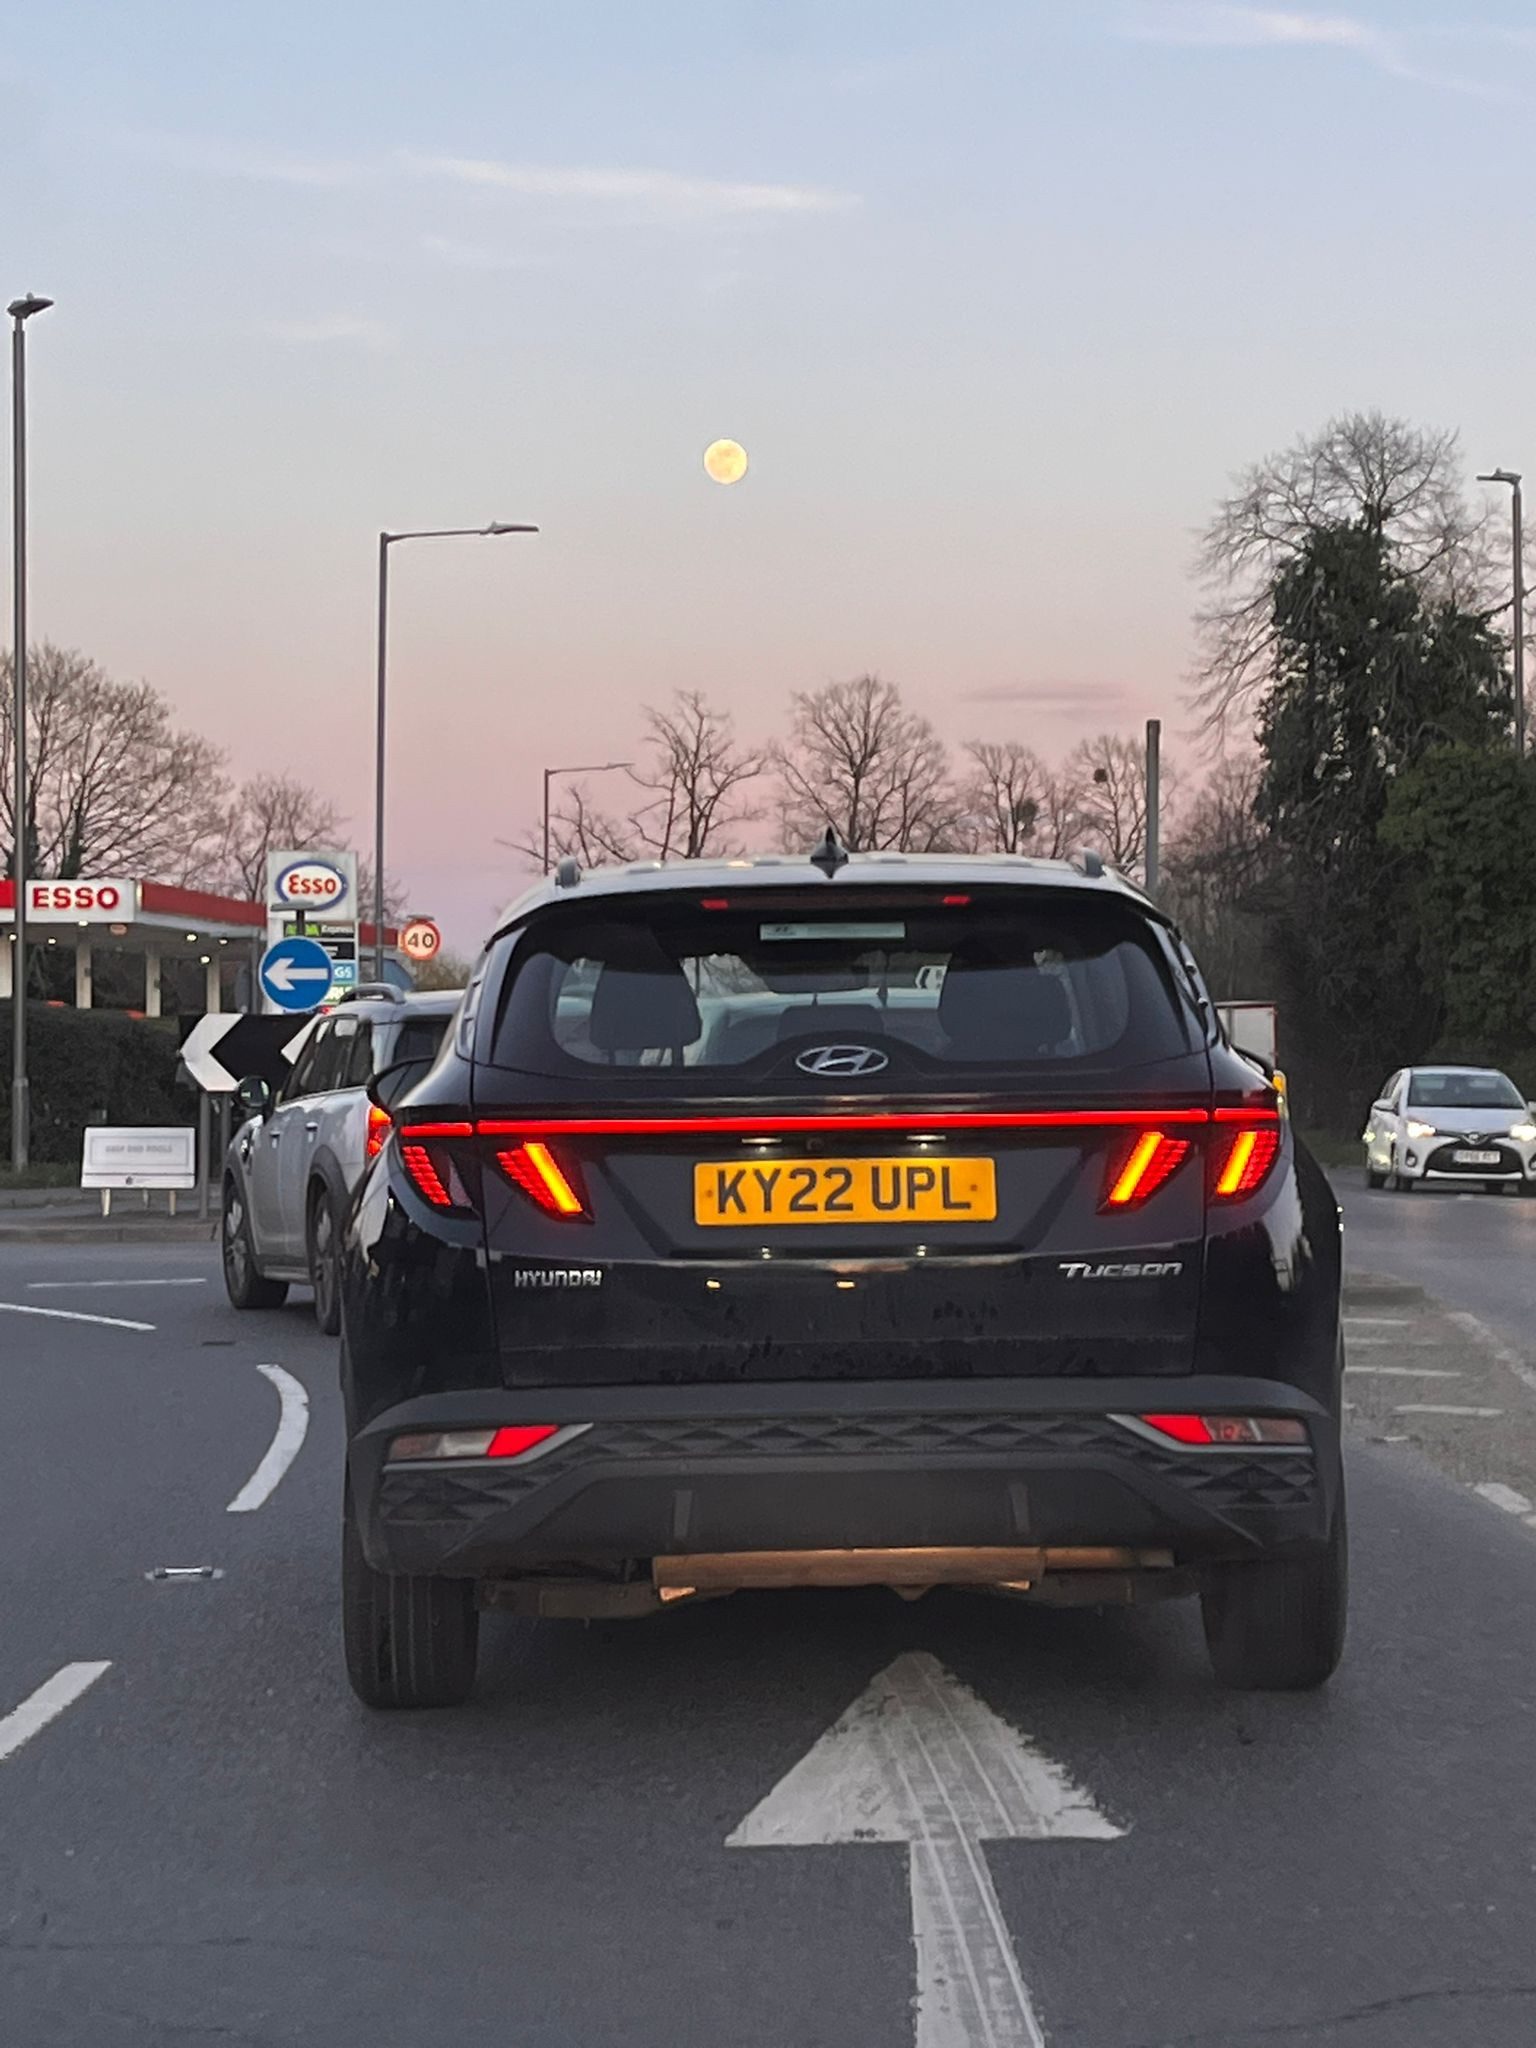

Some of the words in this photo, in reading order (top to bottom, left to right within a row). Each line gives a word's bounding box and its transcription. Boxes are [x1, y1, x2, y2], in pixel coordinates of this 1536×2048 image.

[288, 874, 337, 895] Esso
[33, 887, 119, 909] ESSO
[407, 932, 434, 948] 40
[717, 1167, 853, 1214] KY22
[871, 1166, 972, 1211] UPL
[514, 1270, 602, 1287] HYUNDAI
